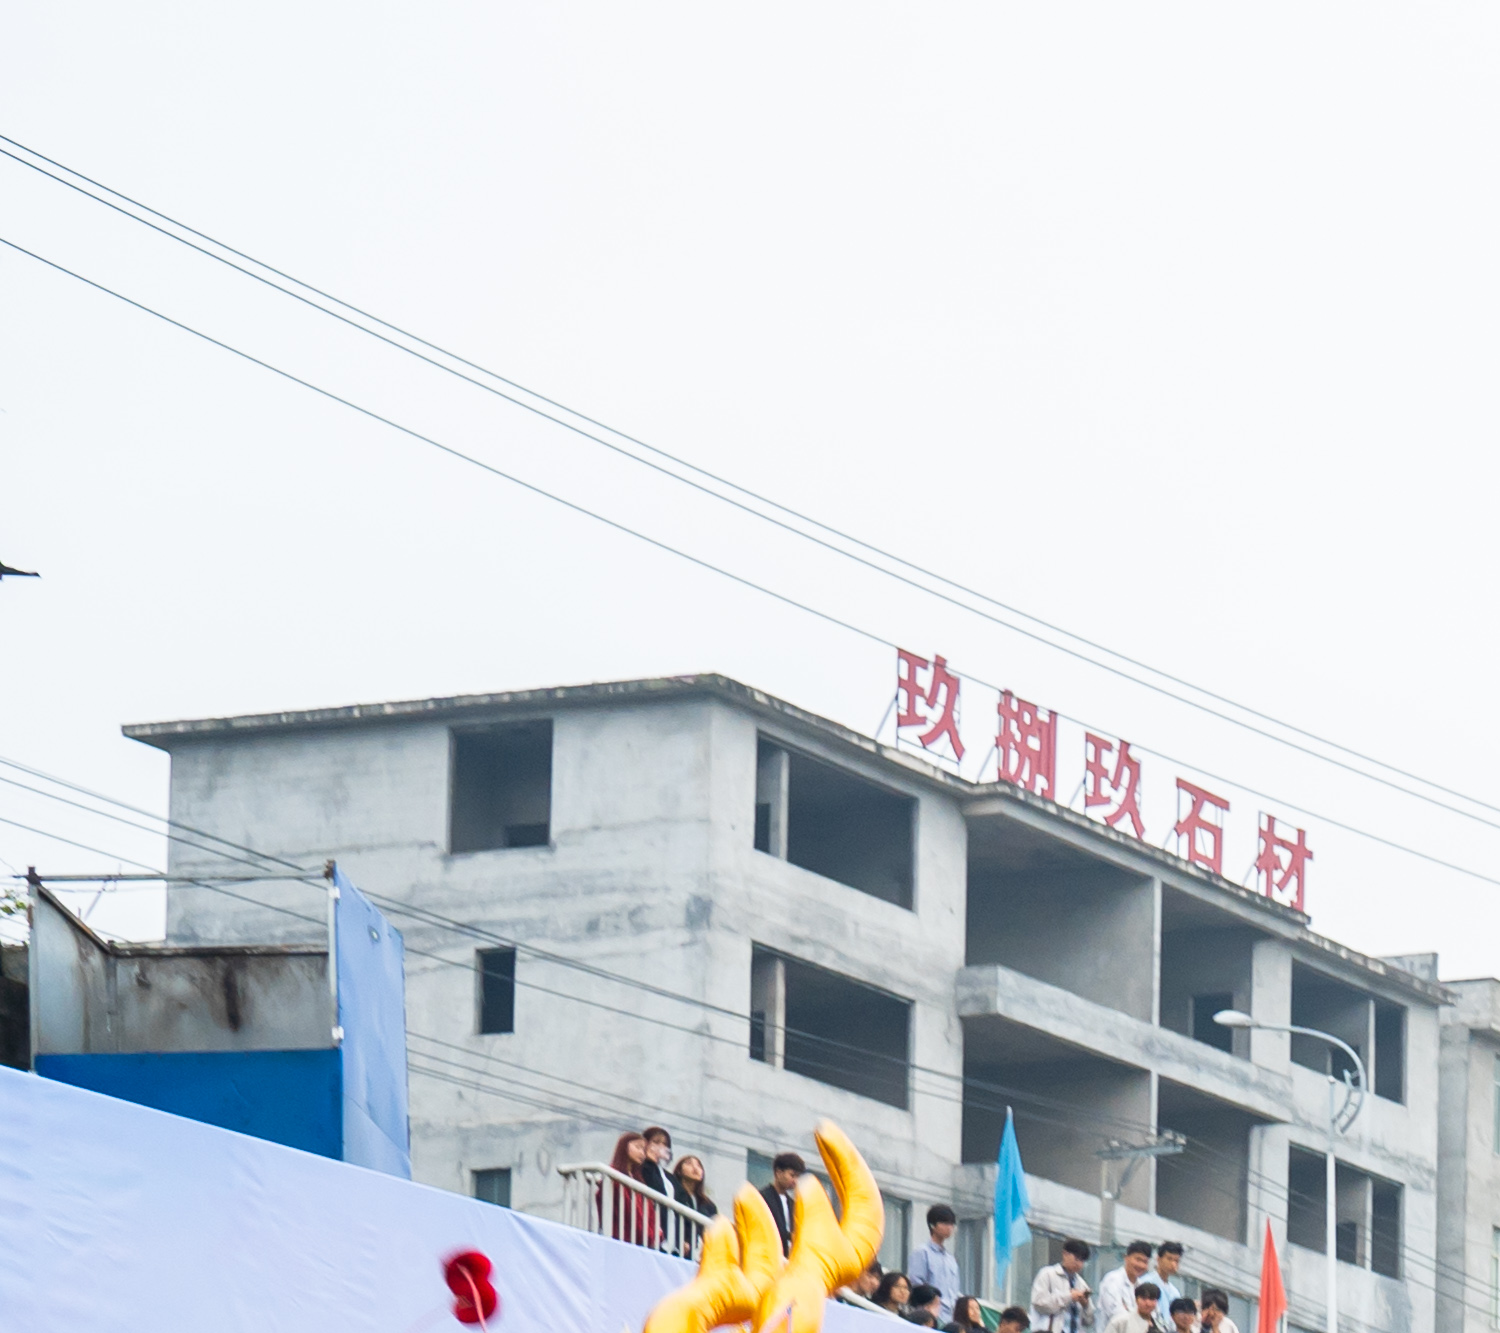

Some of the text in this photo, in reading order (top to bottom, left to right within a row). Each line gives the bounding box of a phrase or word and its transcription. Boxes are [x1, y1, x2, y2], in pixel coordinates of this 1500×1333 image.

[898, 648, 1313, 912] 玖捌玖石材
